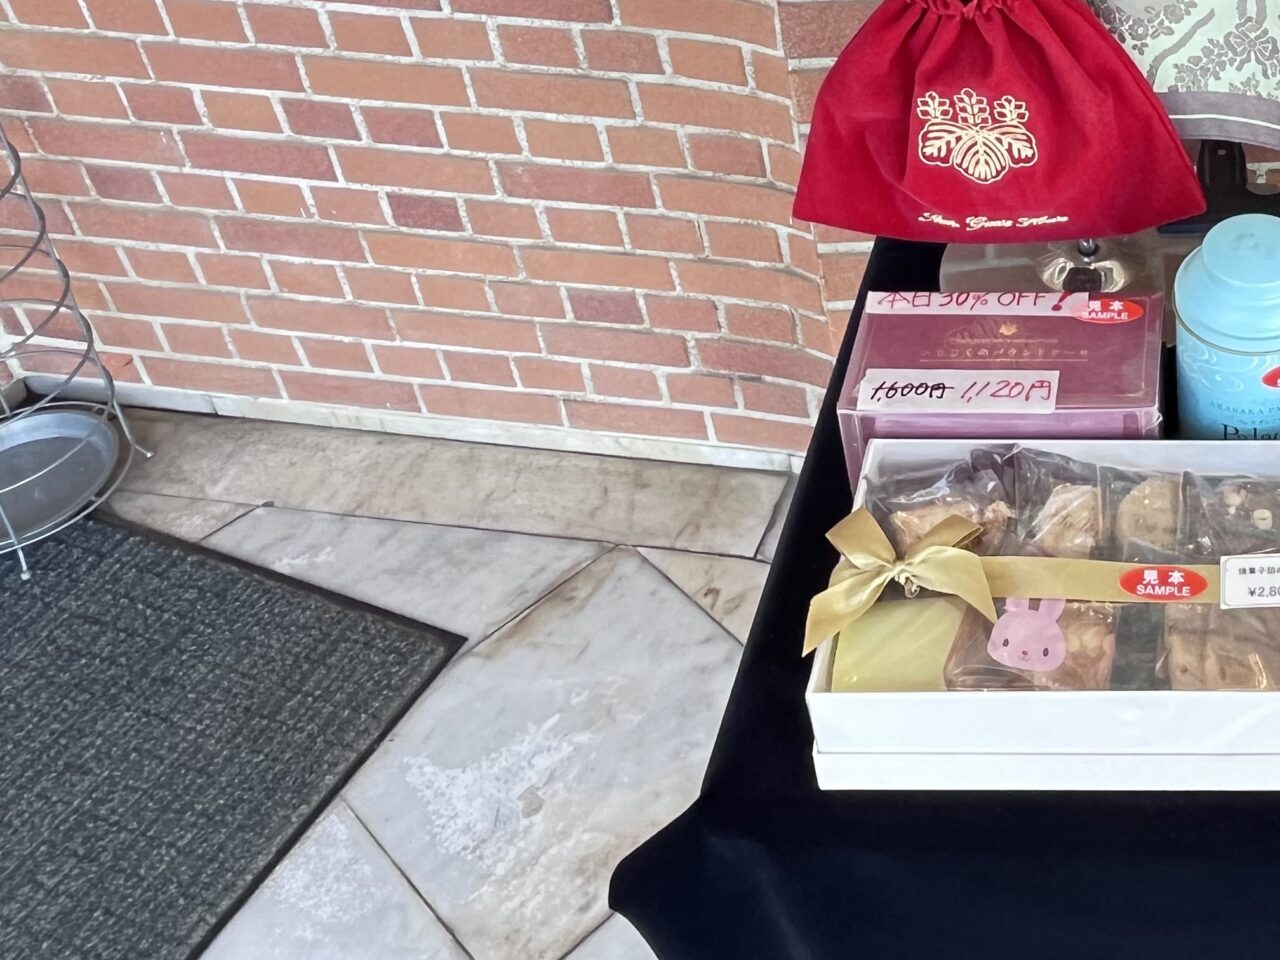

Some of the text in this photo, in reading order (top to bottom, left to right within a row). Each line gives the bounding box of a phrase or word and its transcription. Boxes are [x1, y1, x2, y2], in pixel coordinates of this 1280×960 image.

[877, 291, 931, 309] 本日
[937, 291, 989, 312] 30%
[1088, 300, 1125, 312] 見本
[1082, 311, 1129, 320] SAMPLE
[960, 380, 1053, 403] 1,120円
[1143, 570, 1185, 584] 見本
[1136, 584, 1191, 597] SAMPLE
